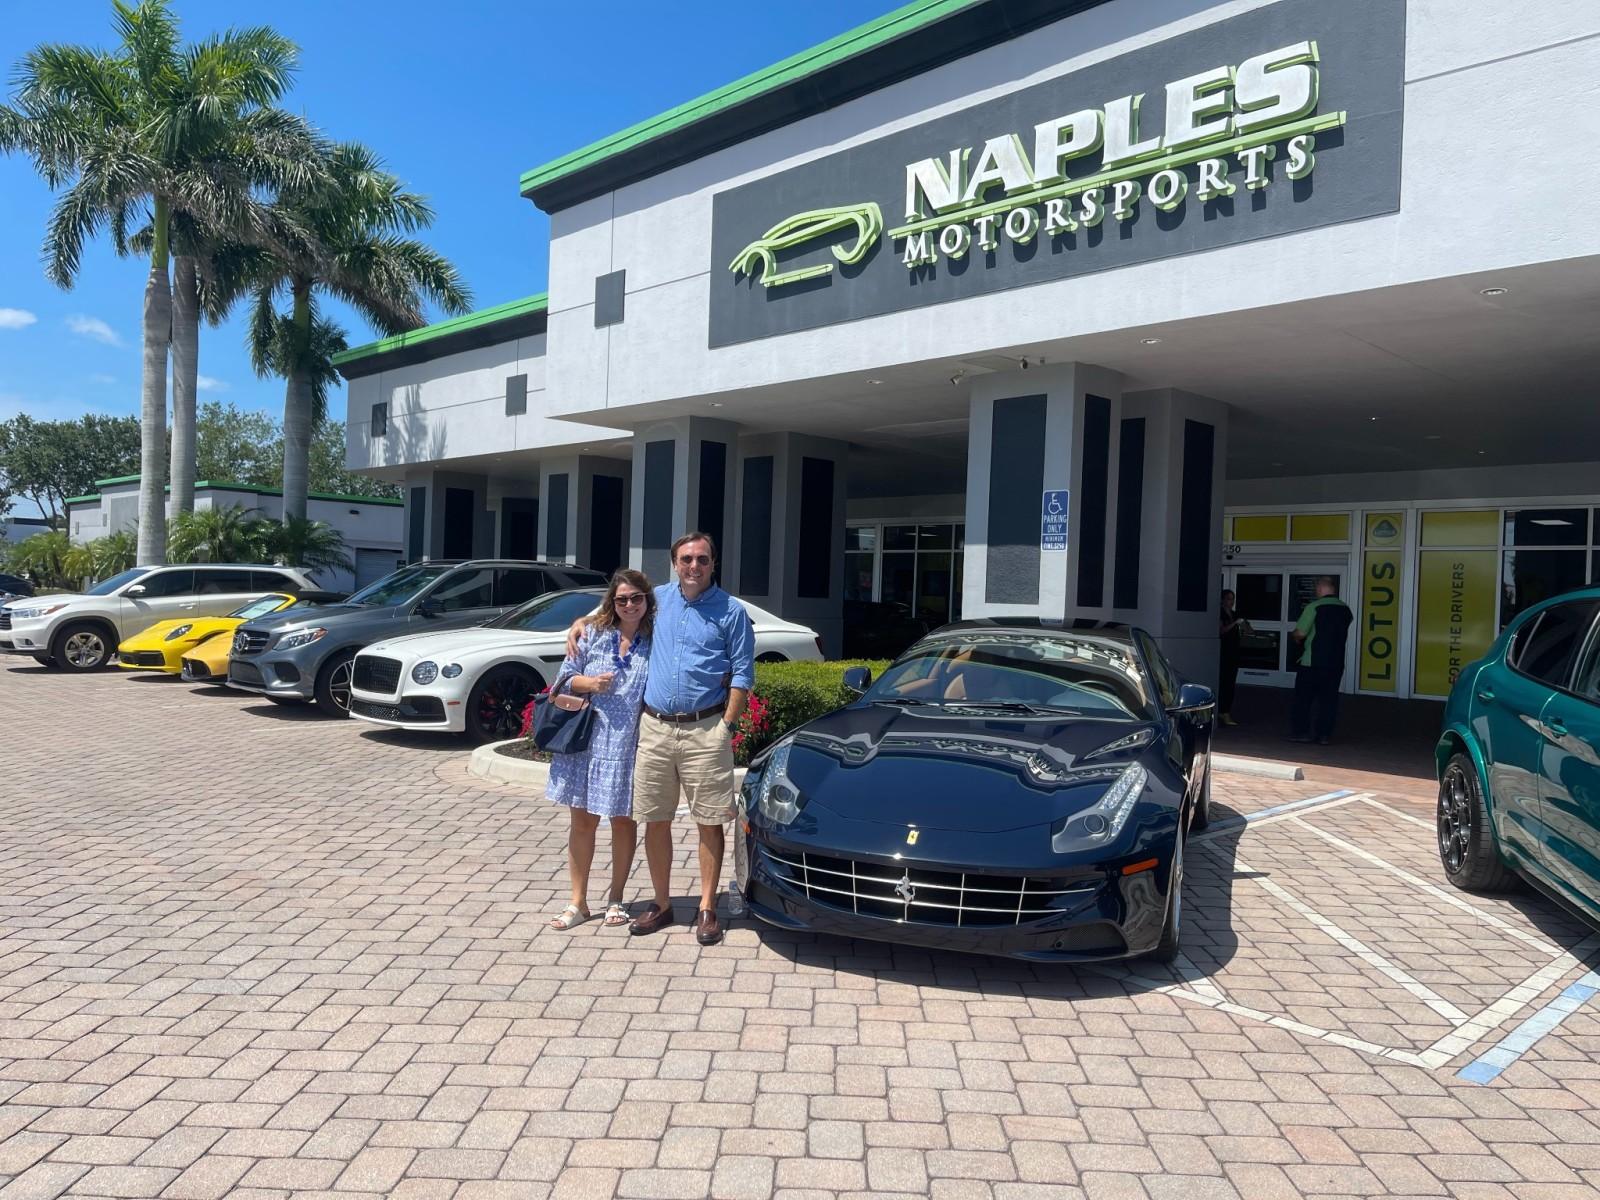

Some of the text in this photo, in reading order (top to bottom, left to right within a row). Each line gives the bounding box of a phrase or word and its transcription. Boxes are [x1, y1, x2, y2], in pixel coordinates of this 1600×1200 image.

[905, 40, 1319, 220] NAPLES
[902, 135, 1315, 267] MOTORSPORTS
[1043, 514, 1067, 524] PARKING
[1047, 524, 1062, 533] ONLY
[1368, 562, 1396, 680] LOTUS
[1451, 562, 1465, 623] DRIVERS
[1449, 623, 1462, 654] THE
